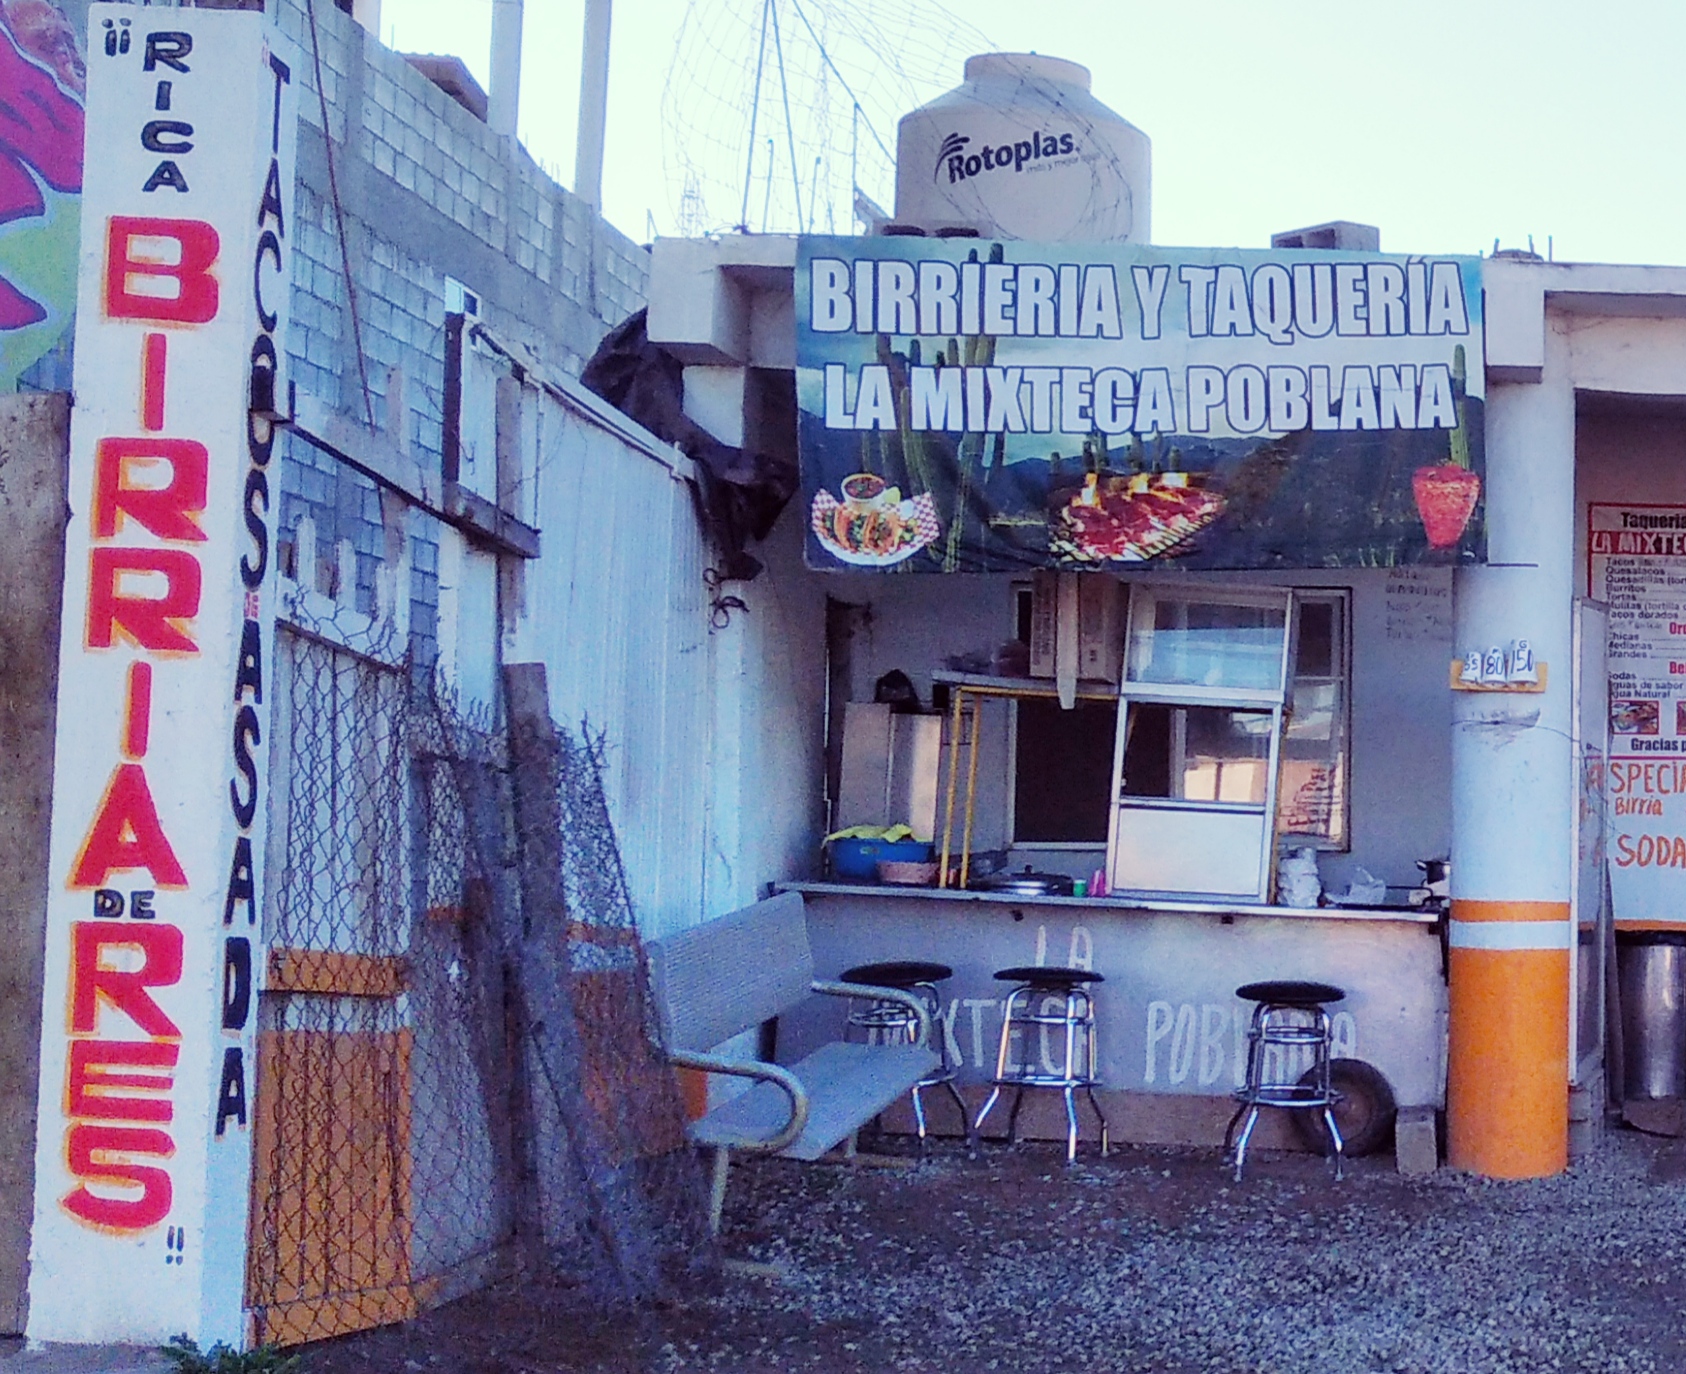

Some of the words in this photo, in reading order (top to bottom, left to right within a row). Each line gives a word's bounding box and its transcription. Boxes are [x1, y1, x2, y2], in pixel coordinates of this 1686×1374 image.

[810, 258, 1122, 339] BIRRIERIA
[1131, 264, 1170, 340] Y
[1179, 255, 1470, 345] TAQUERÍA
[824, 363, 898, 431] LA
[911, 364, 1176, 435] MIXTECA
[1187, 365, 1459, 434] POBLANA
[1592, 532, 1611, 552] LA
[65, 214, 220, 891] BIRRIA
[1606, 557, 1635, 566] Tacos
[1605, 574, 1665, 584] Quesadillas
[1605, 583, 1646, 592] Burritos
[1606, 592, 1636, 601] Tortas
[1610, 611, 1635, 619] acos
[1638, 611, 1679, 619] dorados
[1486, 655, 1504, 675] 80
[1510, 649, 1533, 674] 150
[1611, 681, 1637, 690] guas
[1640, 681, 1652, 689] de
[1655, 681, 1684, 690] sabor
[1611, 690, 1632, 699] gua
[1634, 689, 1671, 698] Natural
[1630, 738, 1678, 751] Gracias
[1615, 796, 1663, 816] Birria
[1615, 834, 1686, 869] SODA
[213, 618, 262, 1142] ASADA
[93, 890, 157, 919] DE
